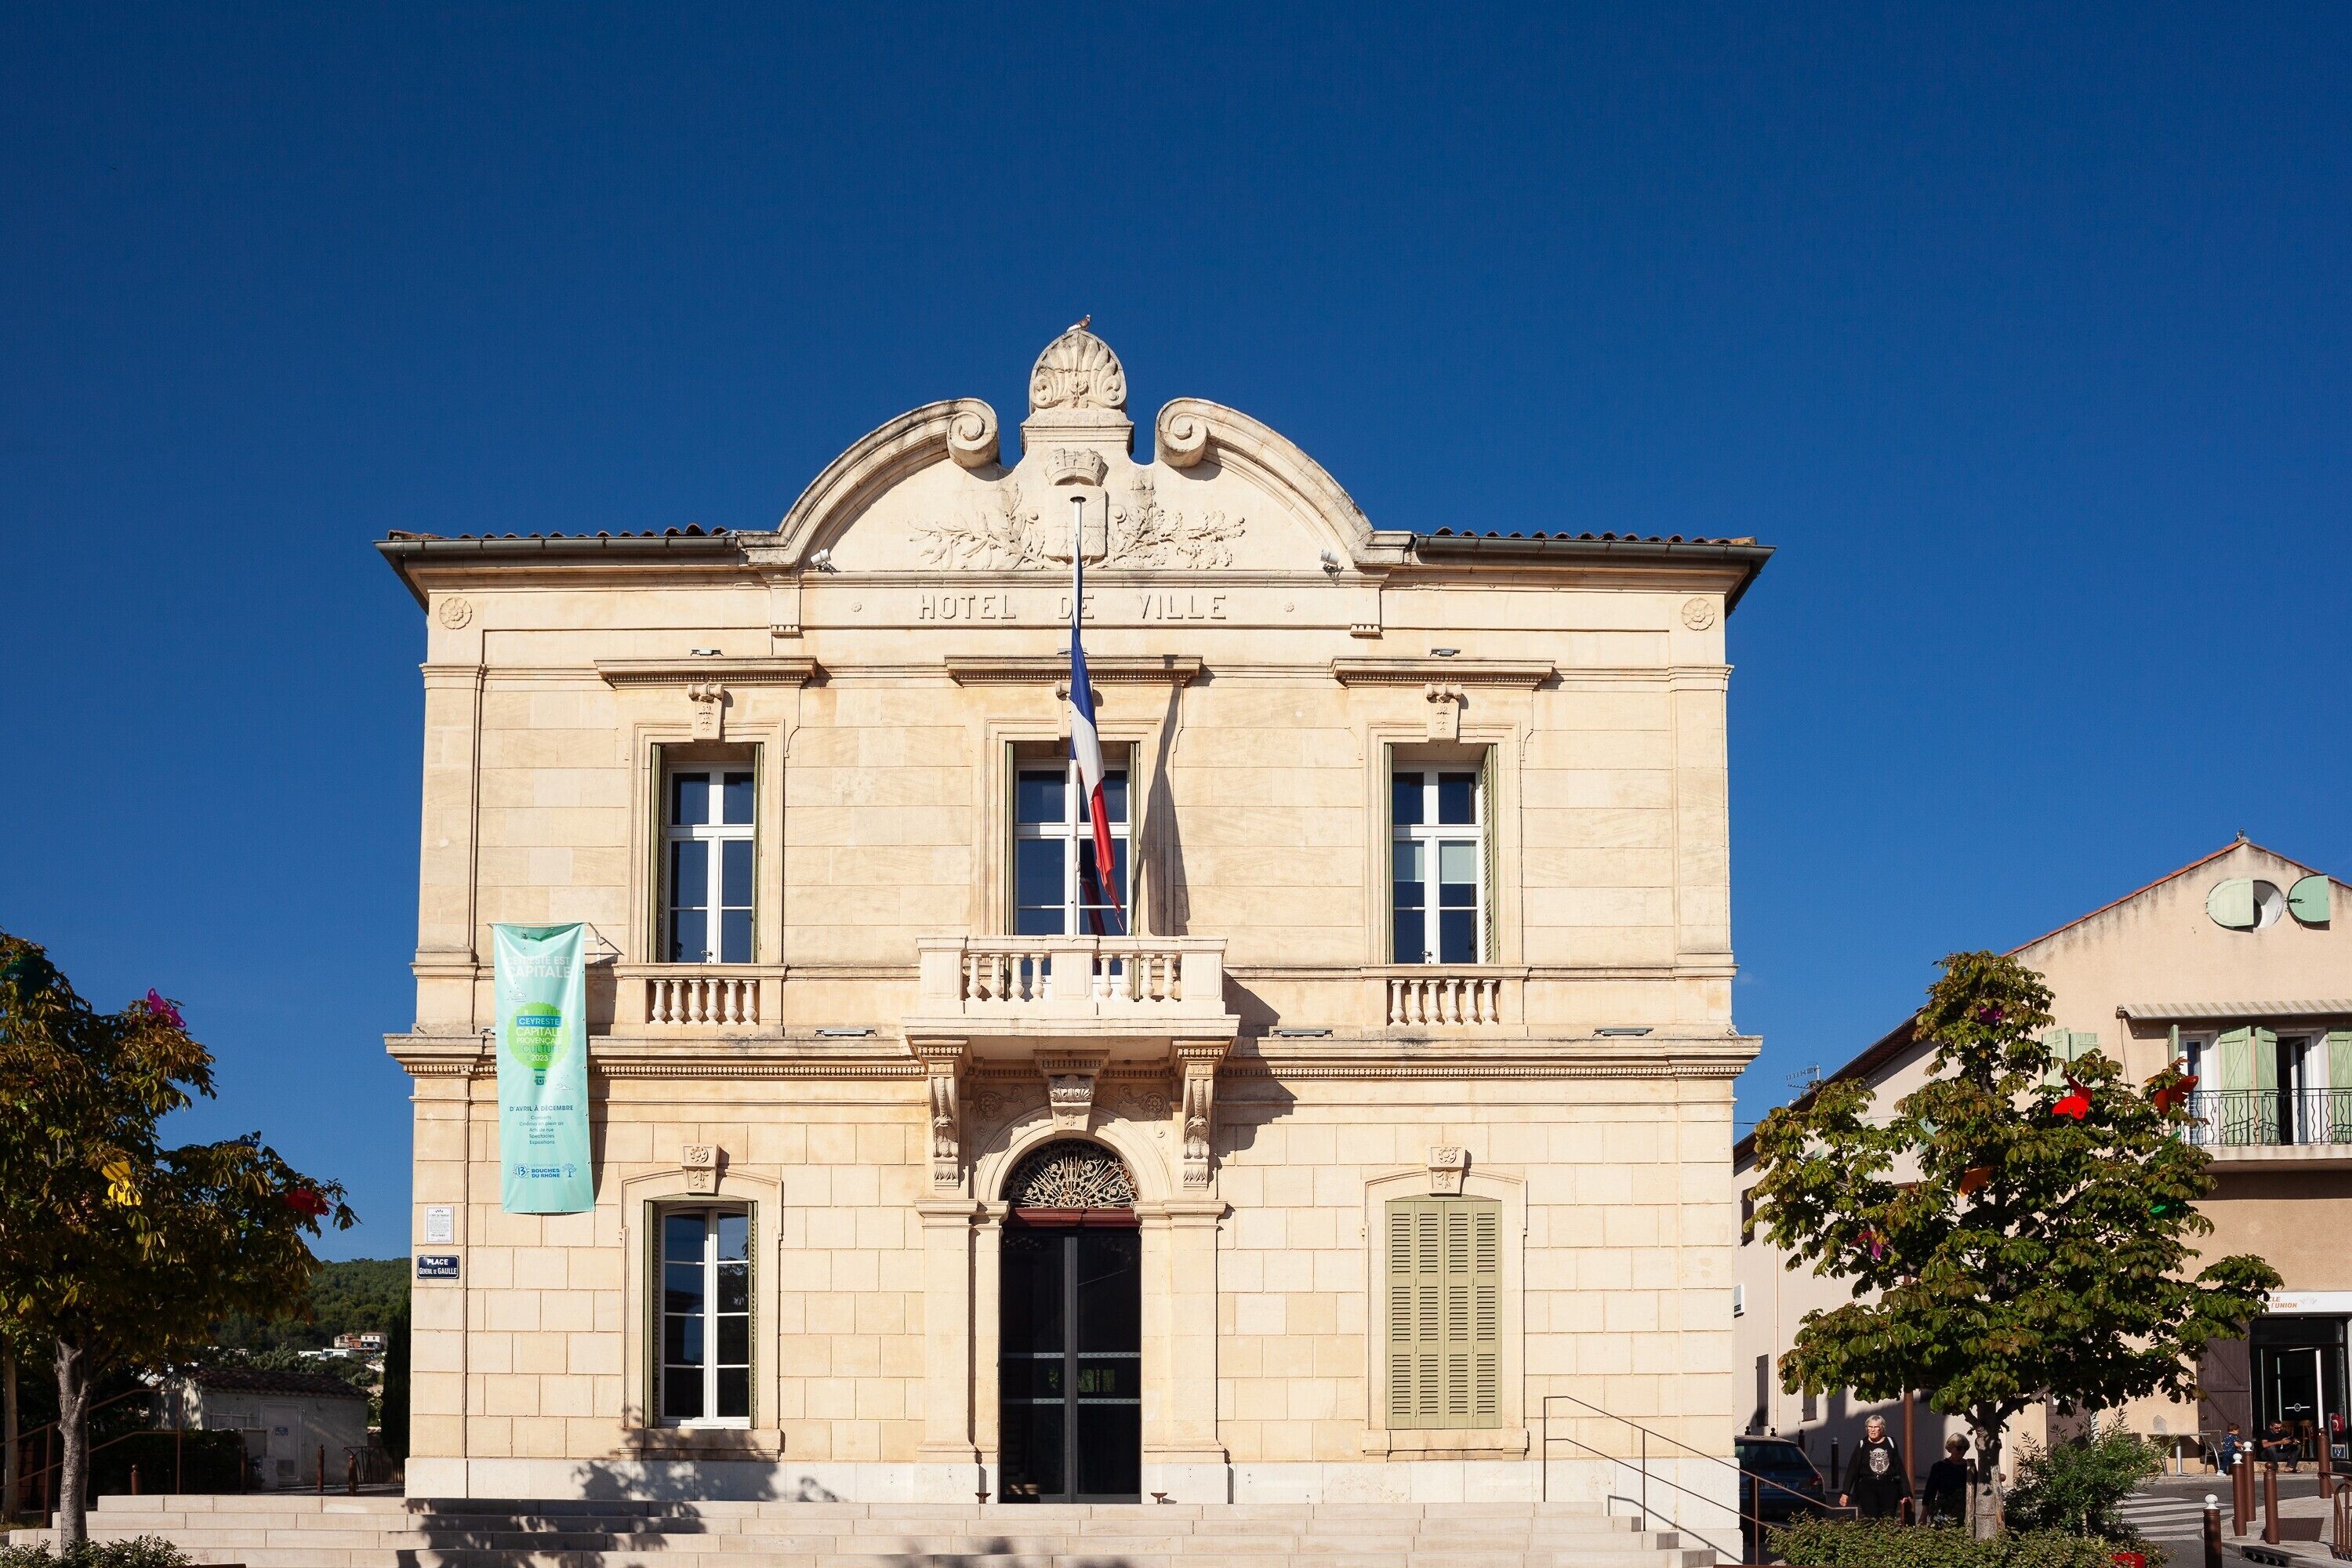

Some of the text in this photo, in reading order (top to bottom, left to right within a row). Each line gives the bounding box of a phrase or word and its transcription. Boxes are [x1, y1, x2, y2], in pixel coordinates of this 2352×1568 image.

[918, 593, 1227, 619] HOTEL DE VILLE
[554, 956, 571, 965] EST
[505, 964, 571, 978] CAPITALE
[515, 1027, 563, 1036] CAPITALE
